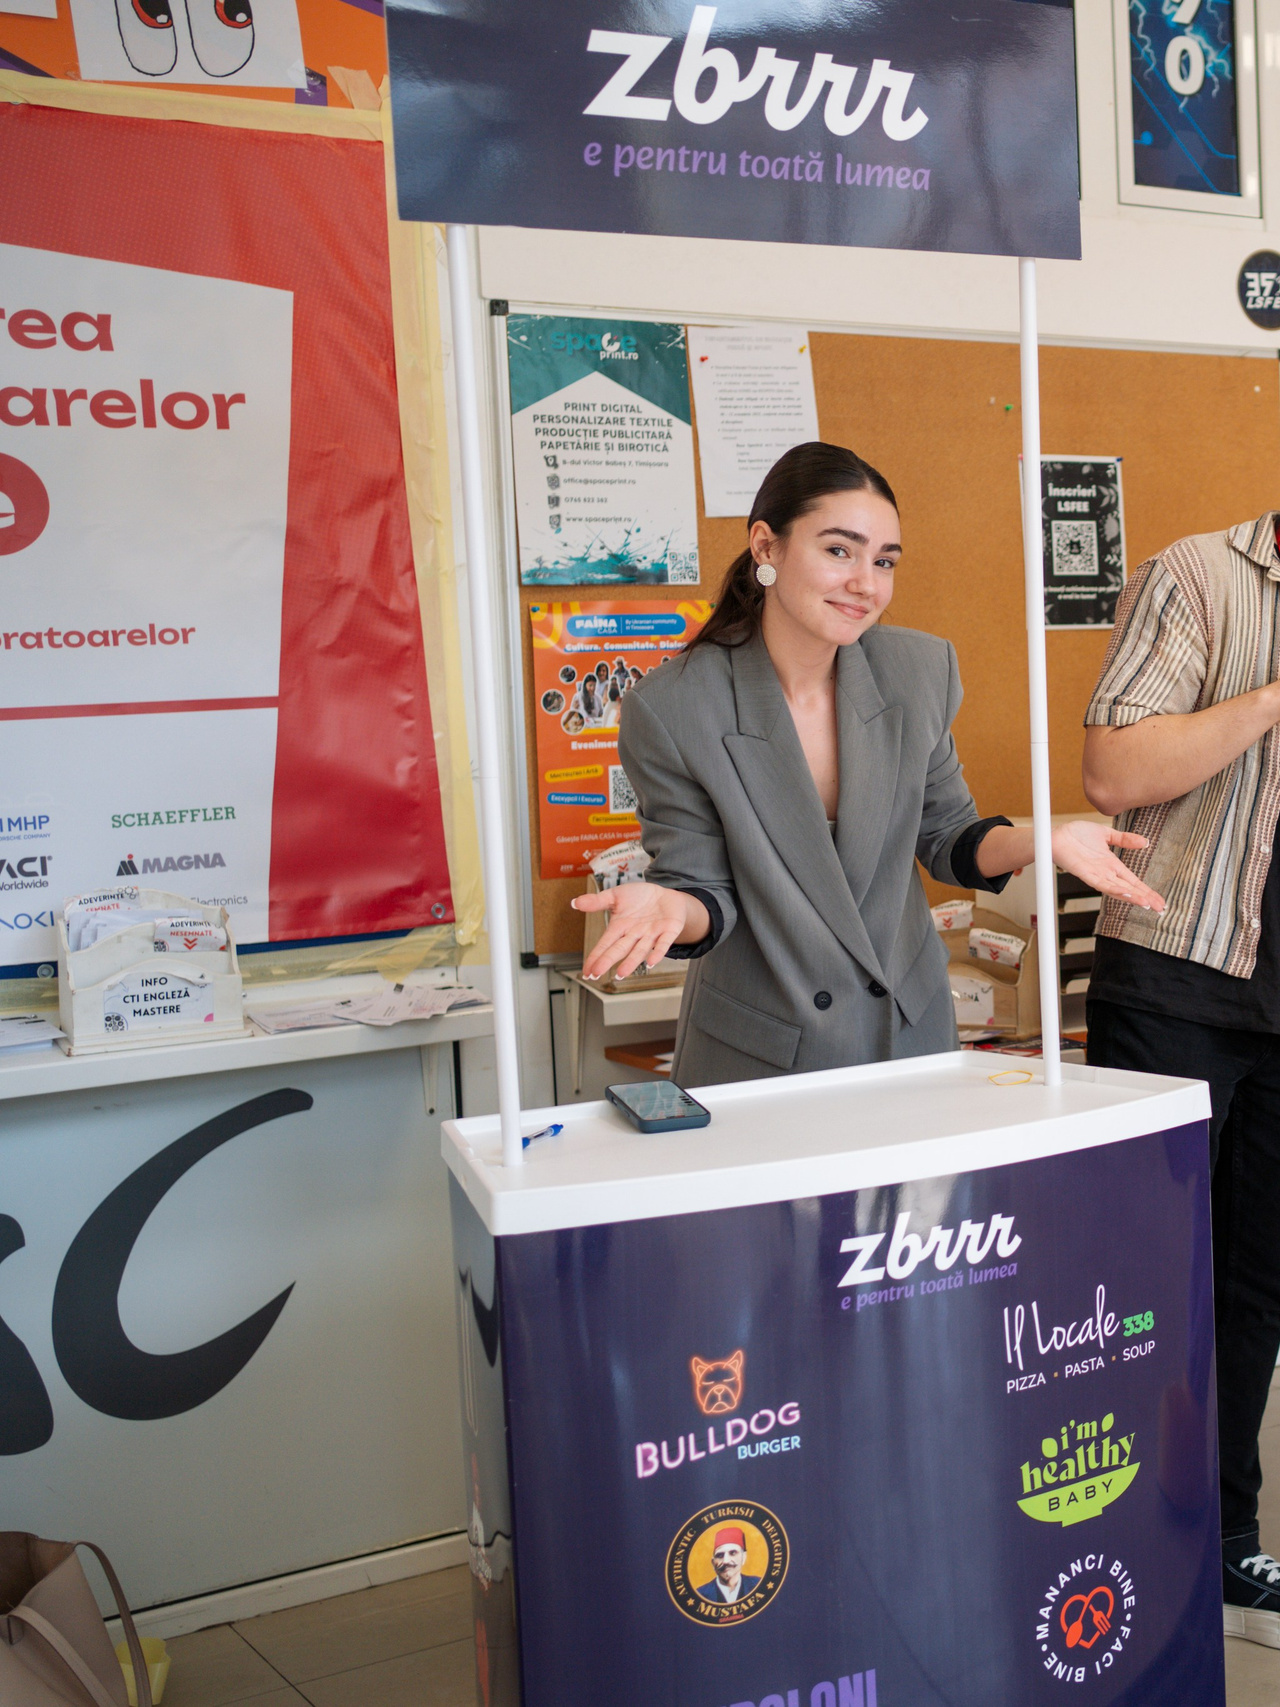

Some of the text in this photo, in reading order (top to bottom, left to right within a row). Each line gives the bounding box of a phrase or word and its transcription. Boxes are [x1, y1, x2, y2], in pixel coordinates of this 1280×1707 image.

[582, 4, 929, 141] zbrrr
[583, 141, 931, 191] e pentru toată lumea
[0, 307, 114, 352] ea
[551, 332, 637, 355] space
[533, 414, 673, 427] PERSONALIZARE TEXTILE
[564, 402, 642, 413] PRINT DIGITAL
[535, 428, 673, 440] PRODUCȚIE PUBLICITARĂ
[540, 440, 601, 451] PAPETĂRIE
[618, 442, 669, 453] BIROTICĂ
[1057, 501, 1090, 513] LSFEE
[0, 623, 196, 650] ratoarelor
[7, 814, 50, 832] MHP
[111, 806, 236, 828] SCHAEFFLER
[142, 852, 226, 874] MAGNA
[141, 976, 168, 987] INFO
[123, 988, 190, 1003] CTI ENGLEZĂ
[133, 1005, 181, 1017] MASTERE
[836, 1212, 1022, 1287] zbrrr
[841, 1260, 1018, 1312] e pentru toată lumea
[1032, 1284, 1120, 1355] Locale
[1122, 1310, 1154, 1337] 338
[1006, 1340, 1155, 1393] PIZZA PASTA SOUP
[635, 1401, 801, 1479] BULLDOG
[737, 1435, 801, 1459] BURGER
[1020, 1432, 1136, 1494] healthy
[1048, 1479, 1113, 1511] BABY
[673, 1506, 782, 1596] AUTHENTIC TURKISH DELIGHTS
[696, 1591, 765, 1617] MUSTAFA
[1036, 1554, 1135, 1640] MANANCI BINE
[1043, 1626, 1131, 1683] FACI BINE
